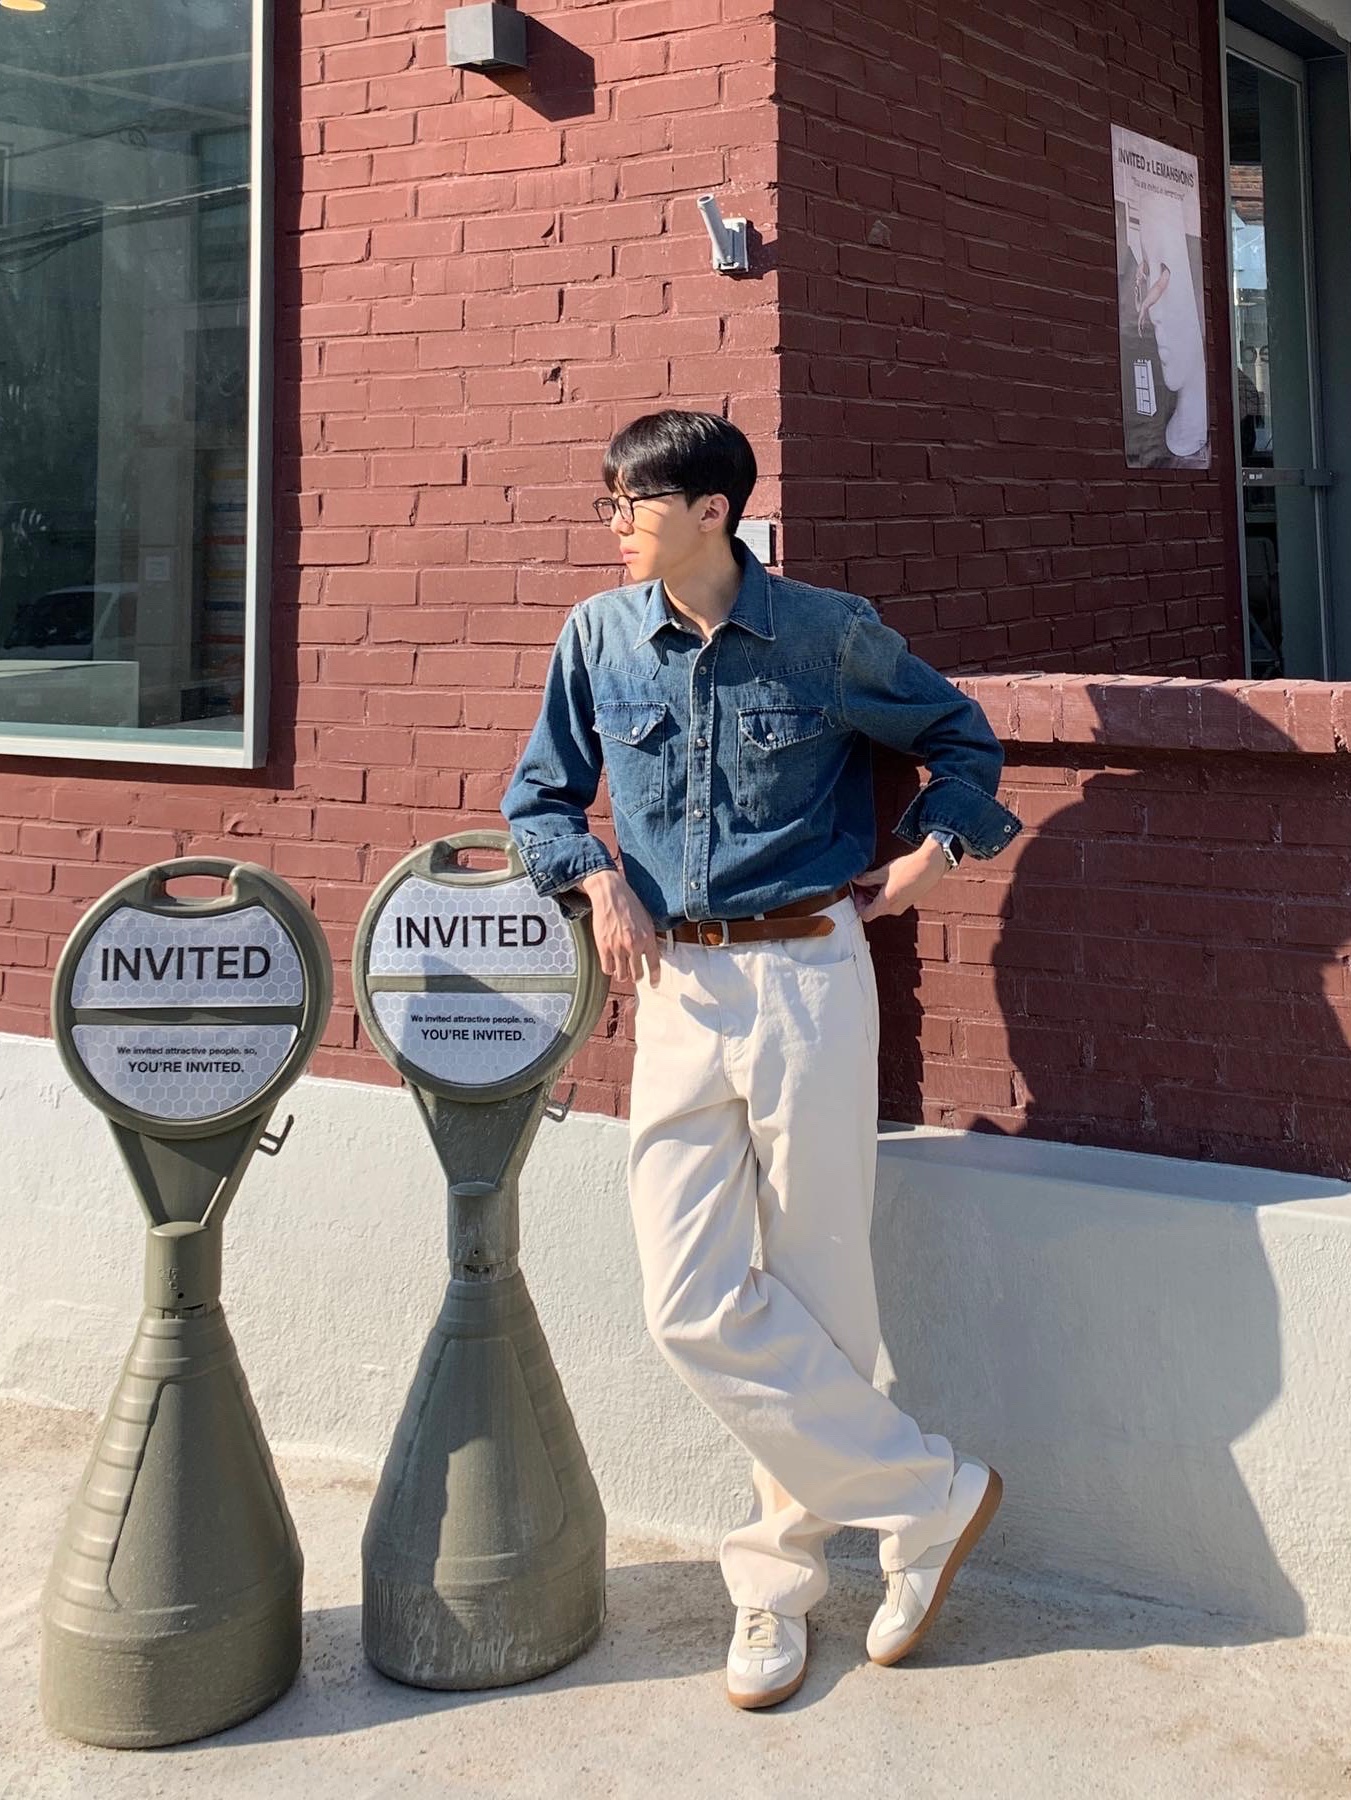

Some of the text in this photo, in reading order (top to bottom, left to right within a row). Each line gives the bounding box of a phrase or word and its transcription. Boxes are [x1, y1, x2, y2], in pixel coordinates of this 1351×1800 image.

[1118, 147, 1146, 170] INVITED
[1151, 160, 1194, 188] LEMANSIONS
[396, 914, 547, 948] INVITED
[101, 946, 271, 981] INVITED
[411, 1014, 423, 1023] We
[425, 1014, 451, 1023] invited
[453, 1015, 490, 1023] attractive
[523, 1016, 536, 1024] so,
[421, 1029, 525, 1041] YOU'RE INVITED.
[117, 1046, 130, 1055] We
[133, 1046, 163, 1055] invited
[165, 1047, 207, 1055] attractive
[128, 1061, 244, 1073] YOU'RE INVITED.
